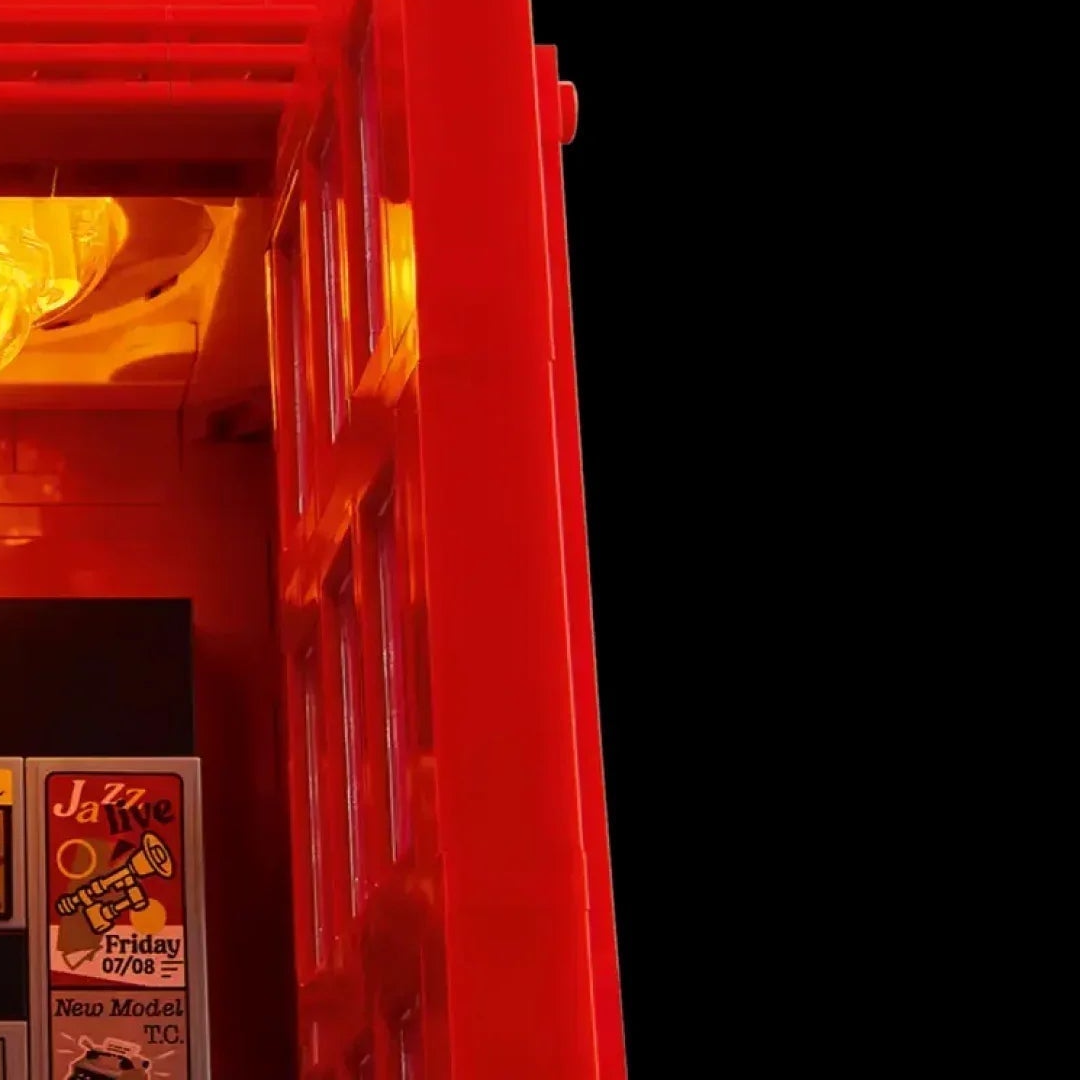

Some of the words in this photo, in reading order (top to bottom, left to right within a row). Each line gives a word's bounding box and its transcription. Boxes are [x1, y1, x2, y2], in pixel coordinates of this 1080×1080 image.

[105, 933, 180, 959] Friday
[102, 956, 155, 977] 07/08
[54, 998, 104, 1017] New
[109, 998, 184, 1017] Model
[143, 1024, 184, 1045] T.C.
